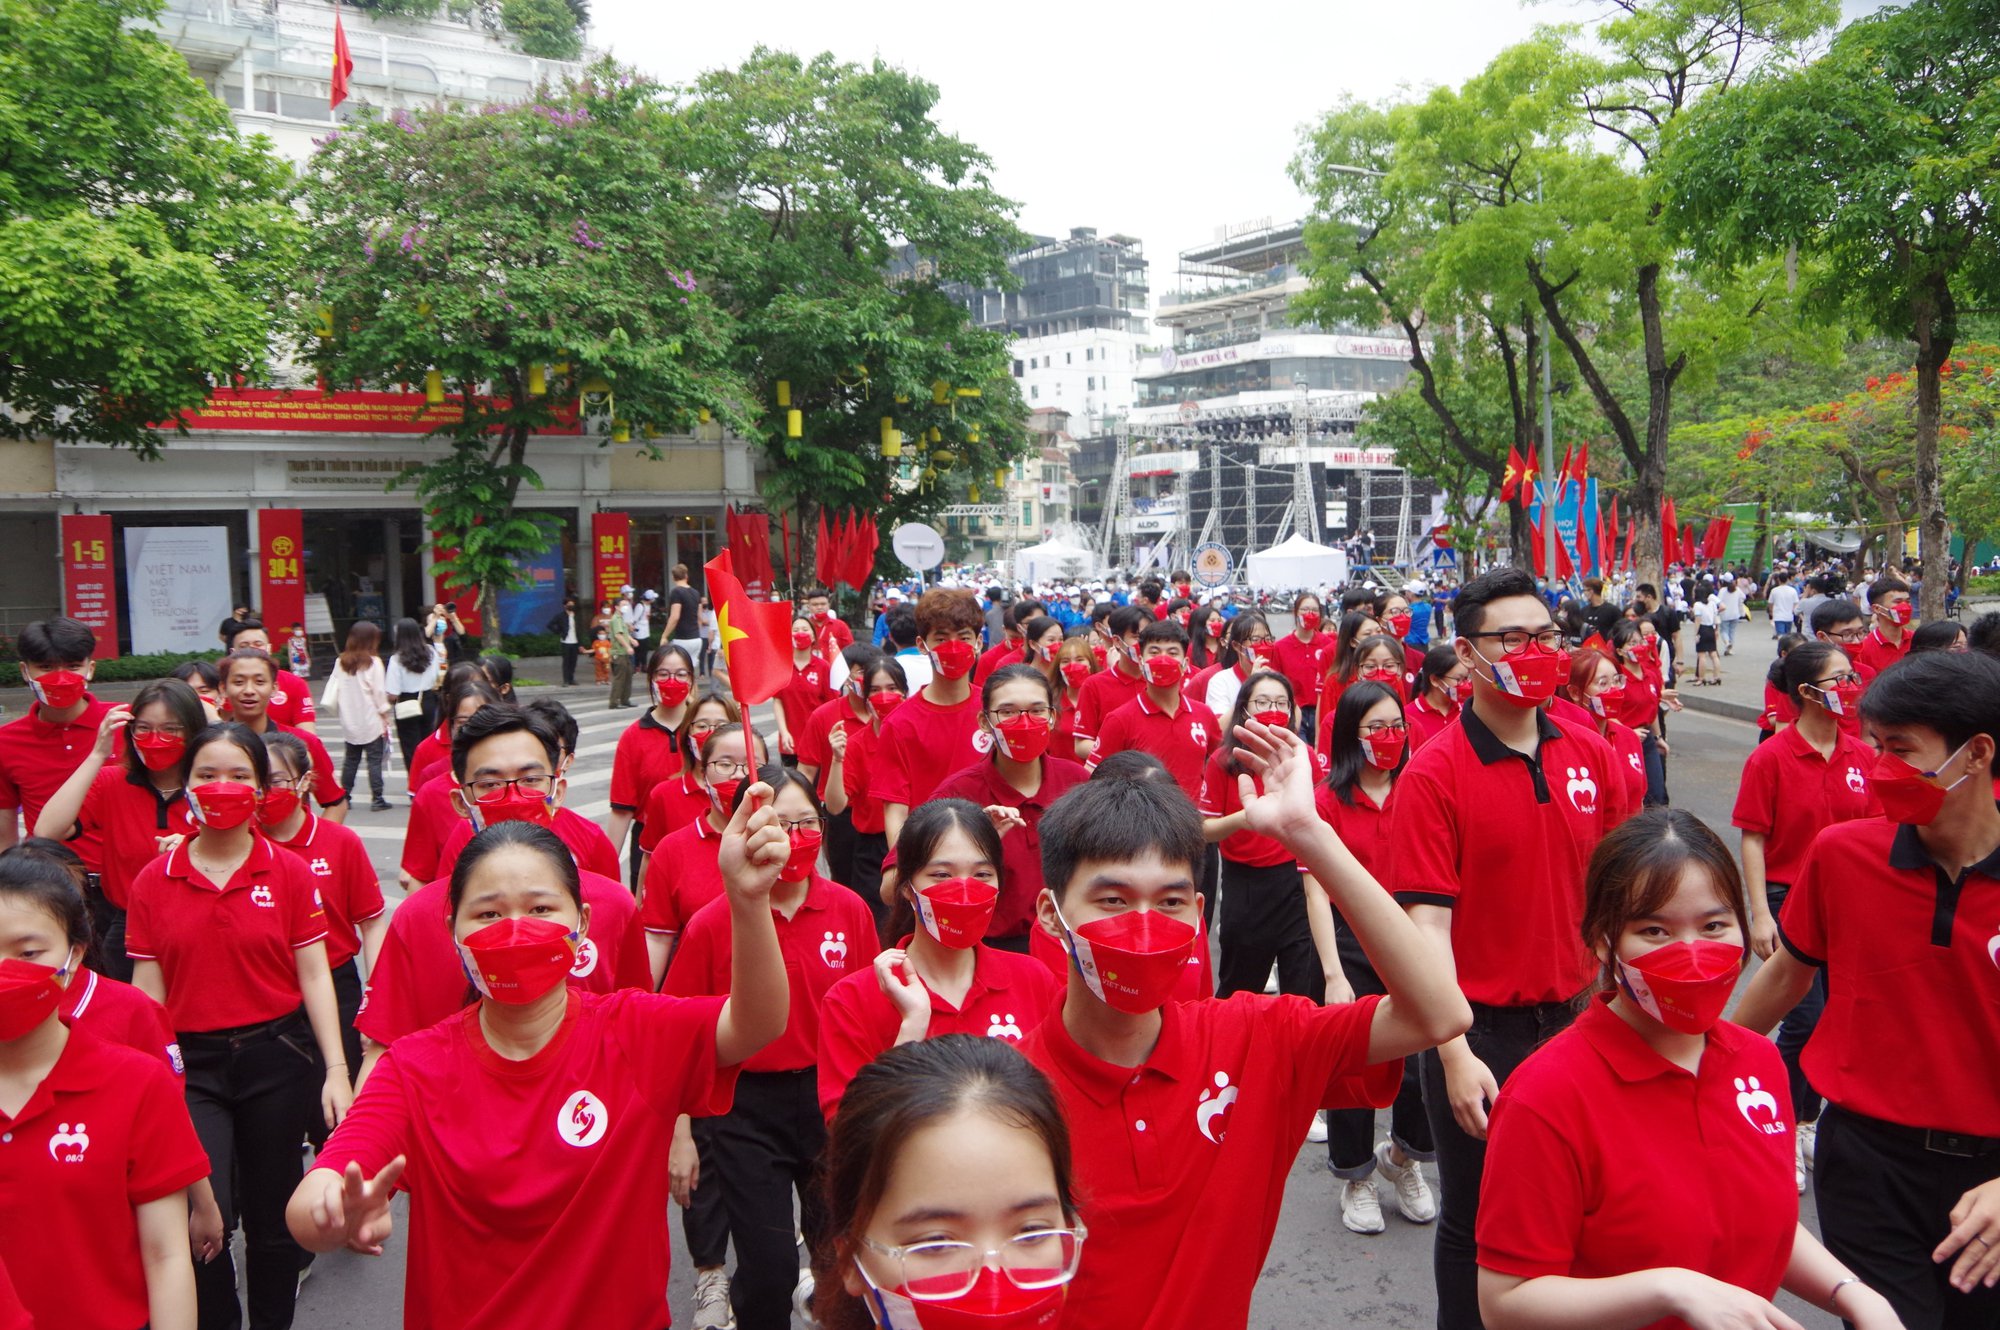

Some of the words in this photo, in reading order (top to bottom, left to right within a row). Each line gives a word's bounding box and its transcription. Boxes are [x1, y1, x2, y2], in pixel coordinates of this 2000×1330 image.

[72, 540, 105, 562] 1-5
[600, 535, 624, 552] 30-4
[179, 564, 211, 574] NAM
[269, 558, 298, 578] 30-4
[1102, 978, 1120, 989] VIET
[1120, 985, 1139, 995] NAM
[65, 1154, 84, 1162] 08/3
